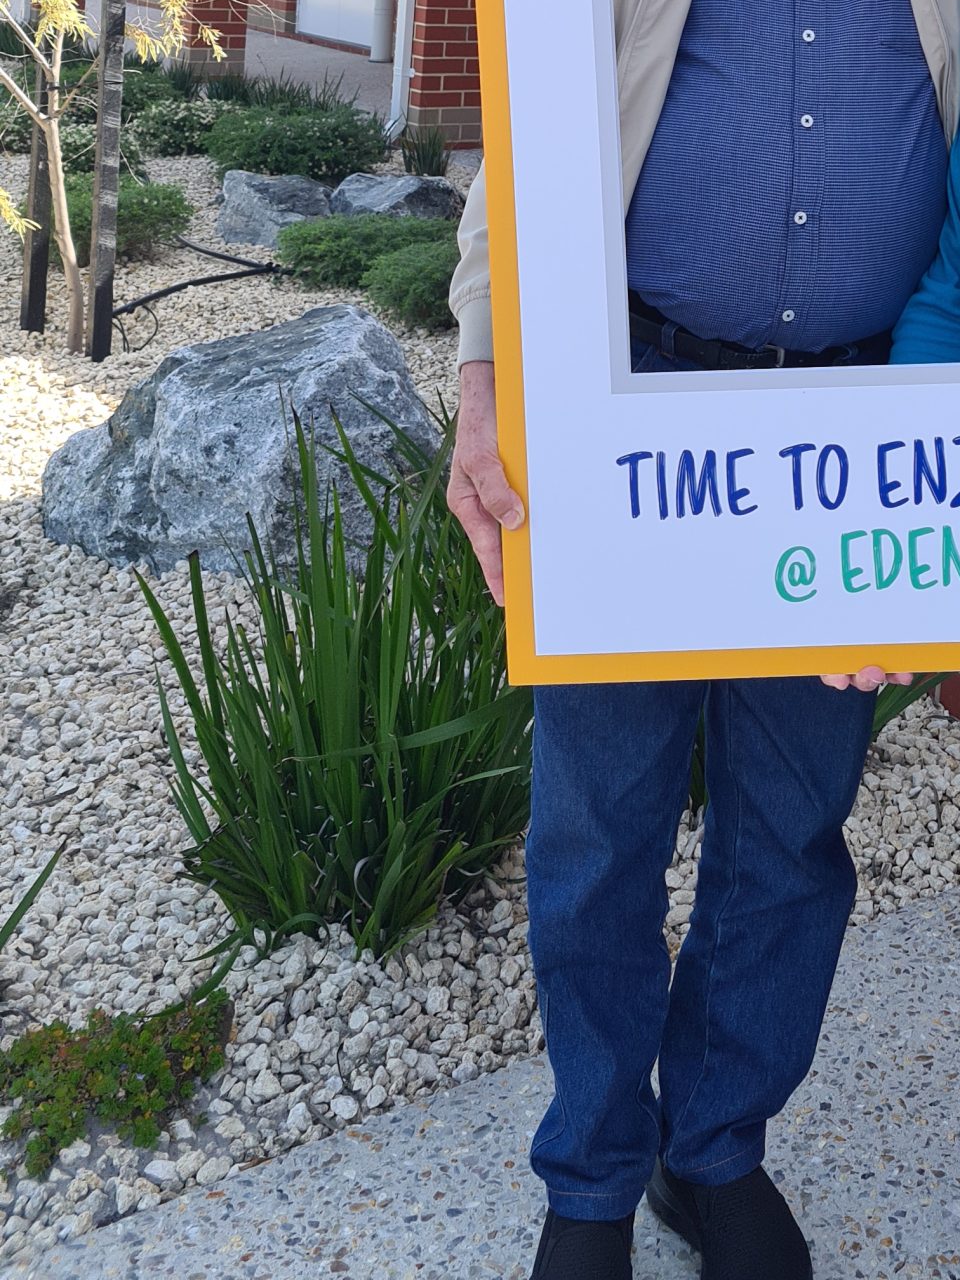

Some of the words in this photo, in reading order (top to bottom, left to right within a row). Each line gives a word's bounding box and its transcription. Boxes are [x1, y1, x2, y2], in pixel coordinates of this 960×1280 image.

[615, 447, 759, 521] TIME
[778, 442, 850, 512] TO
[774, 545, 818, 604] @
